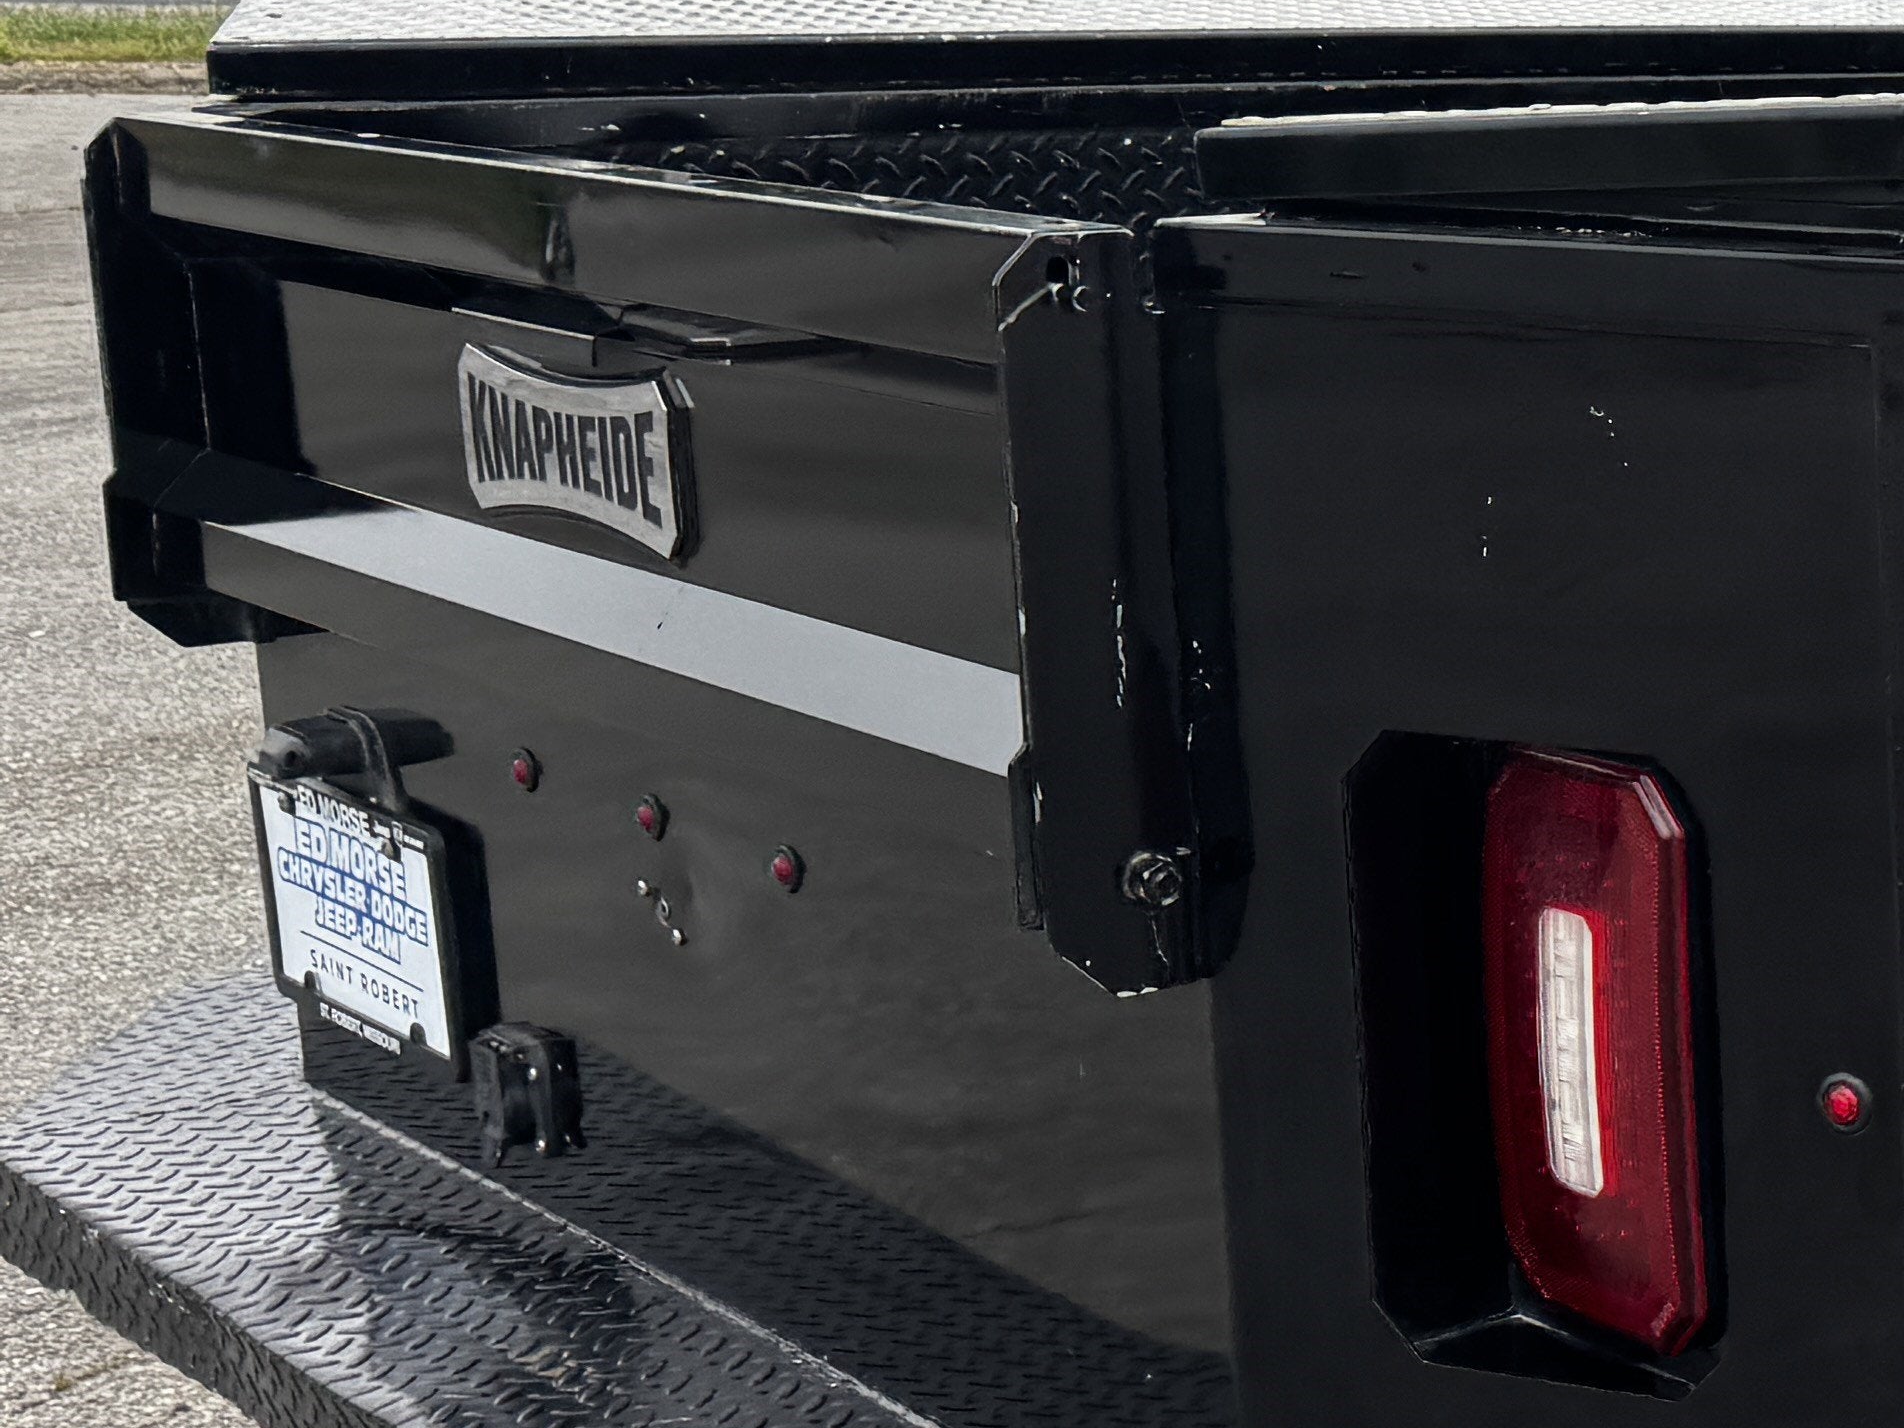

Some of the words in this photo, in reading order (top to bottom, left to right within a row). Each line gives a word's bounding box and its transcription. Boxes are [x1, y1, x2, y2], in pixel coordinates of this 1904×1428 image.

[467, 371, 663, 530] KNAPHEIDE
[297, 784, 317, 815] ED
[317, 793, 371, 838] MORSE
[296, 818, 327, 864] ED
[330, 828, 406, 902] MORSE
[316, 896, 357, 940] JEEP
[361, 916, 401, 964] RAM
[371, 889, 428, 946] DODGE
[310, 949, 352, 984] SAINT
[360, 973, 419, 1019] ROBERT
